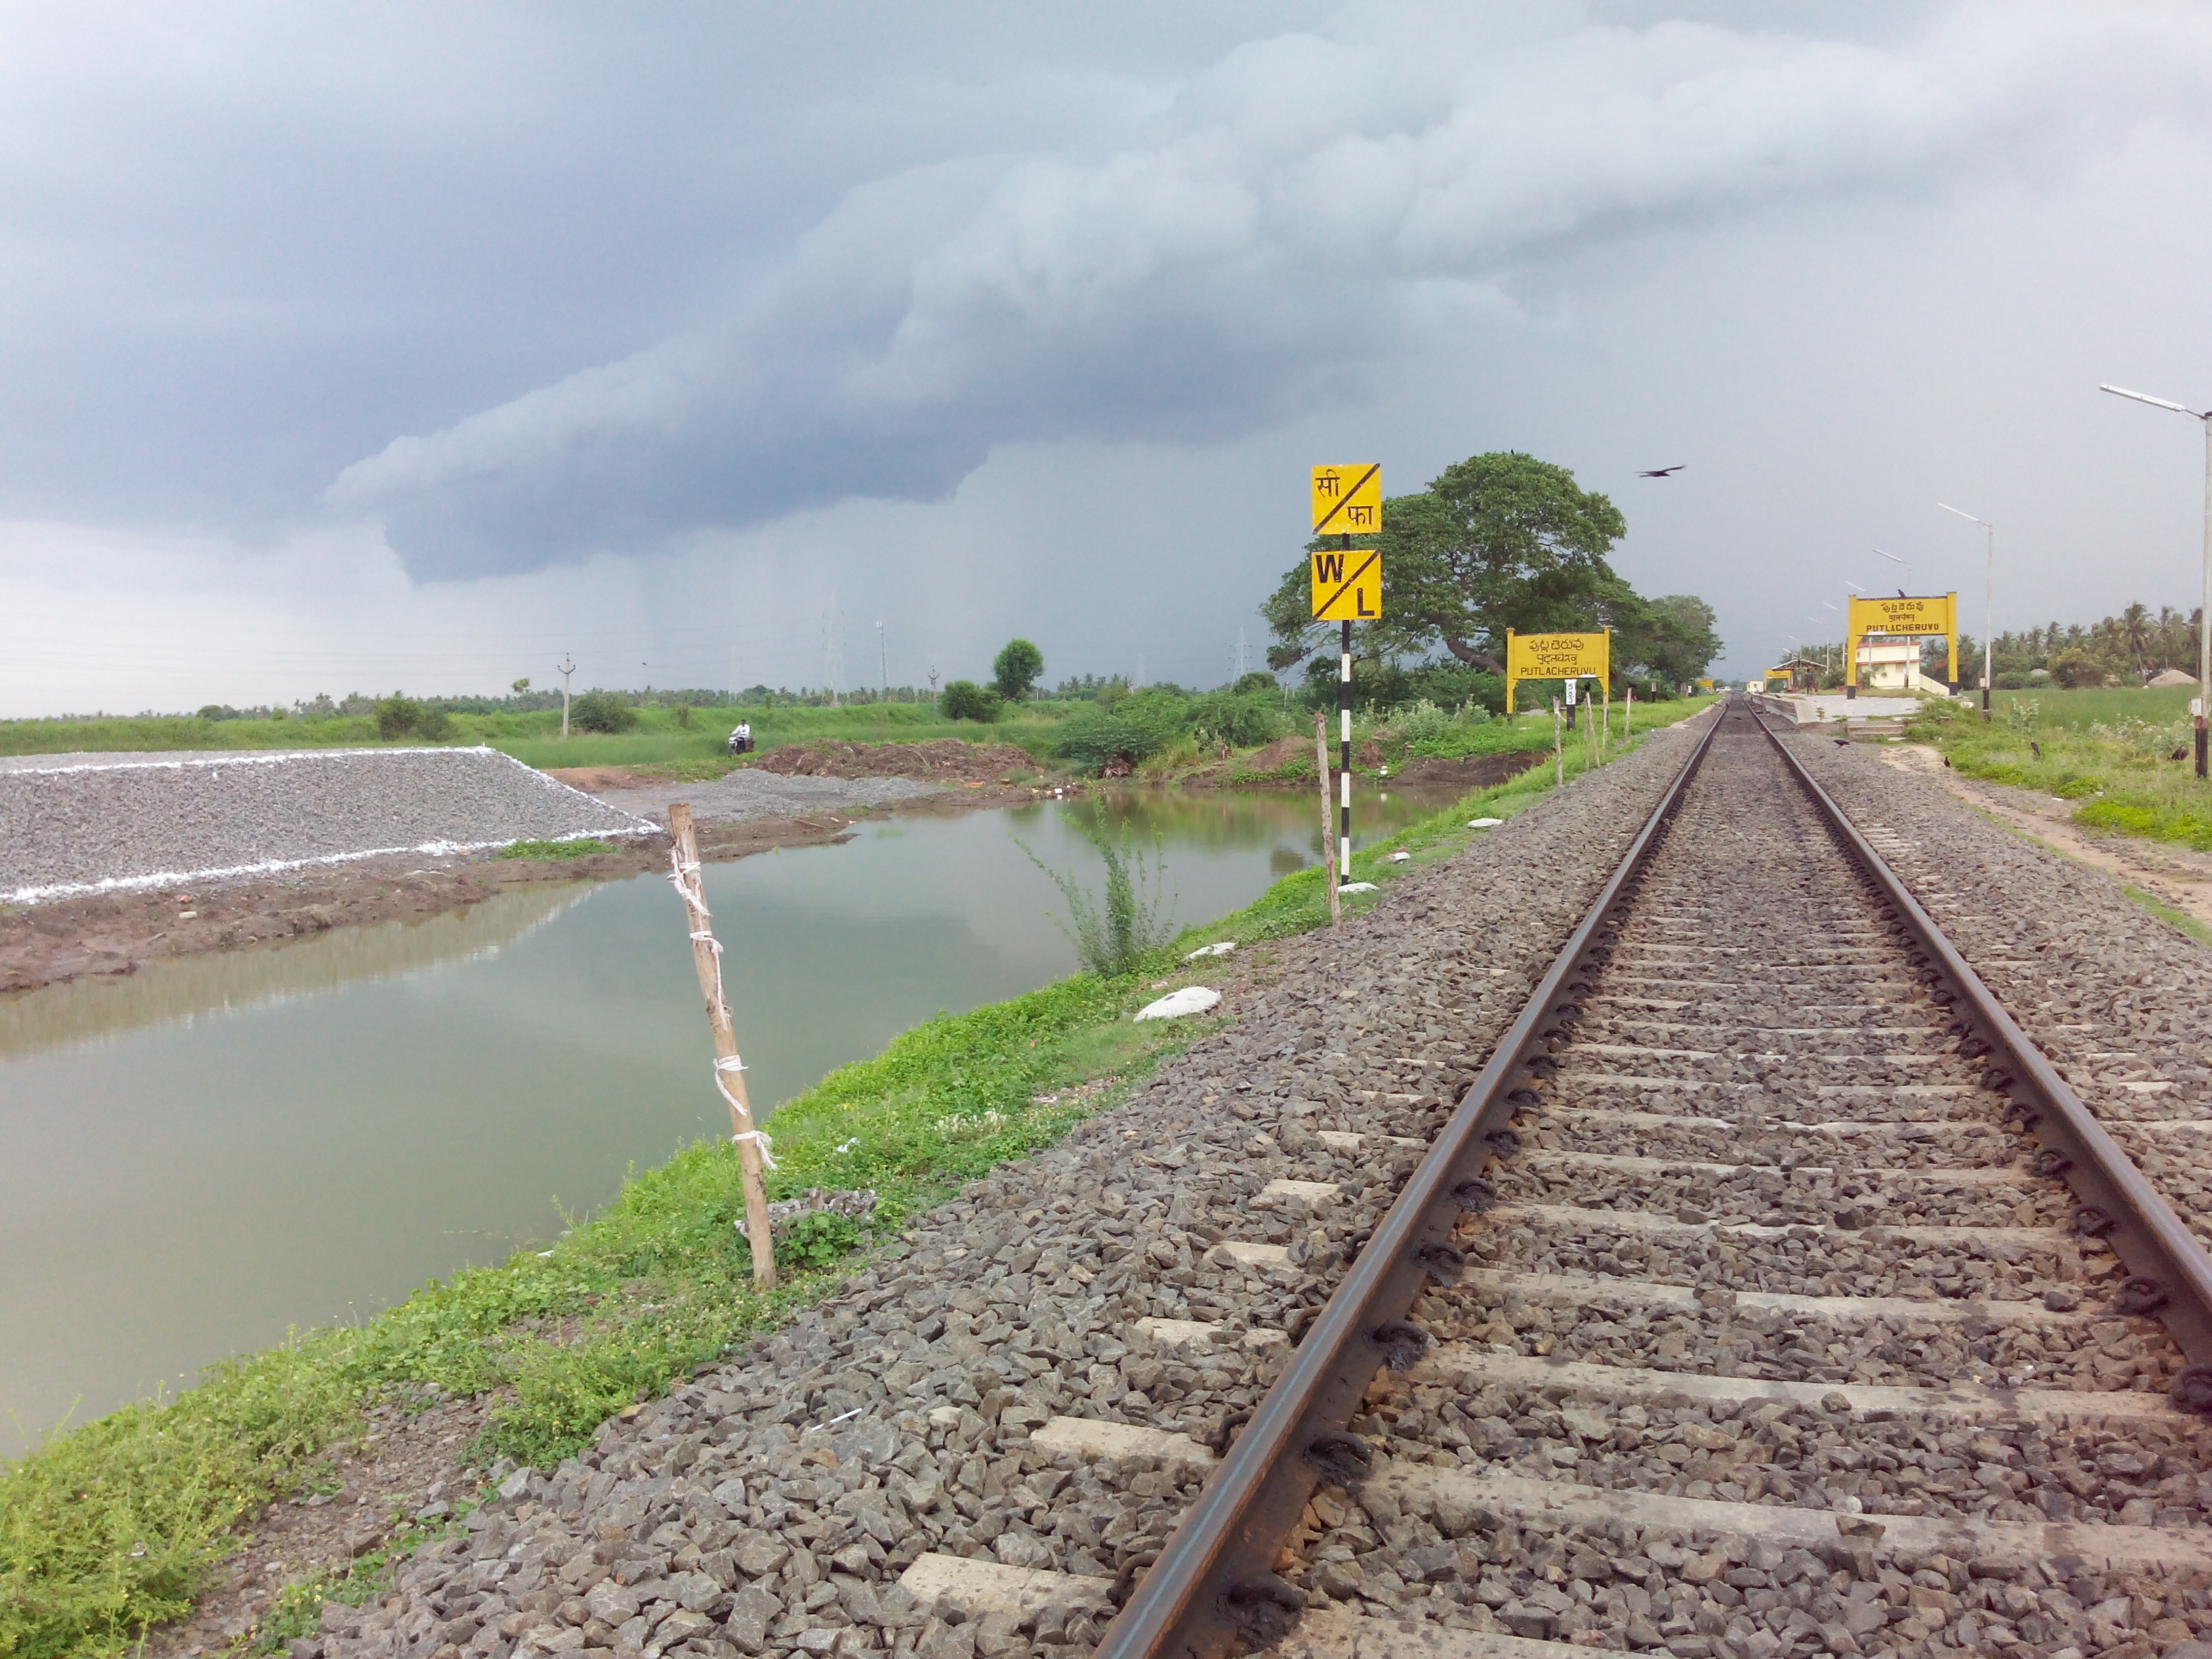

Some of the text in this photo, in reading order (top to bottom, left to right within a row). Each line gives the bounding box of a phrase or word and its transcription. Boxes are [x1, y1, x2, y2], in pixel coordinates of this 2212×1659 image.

[1315, 469, 1340, 497] सी
[1347, 506, 1373, 526] फा
[1315, 554, 1344, 583] W
[1357, 588, 1374, 616] L
[1866, 623, 1939, 632] PUTLACHERUVU
[1521, 667, 1596, 676] PUTLACHERUVU
